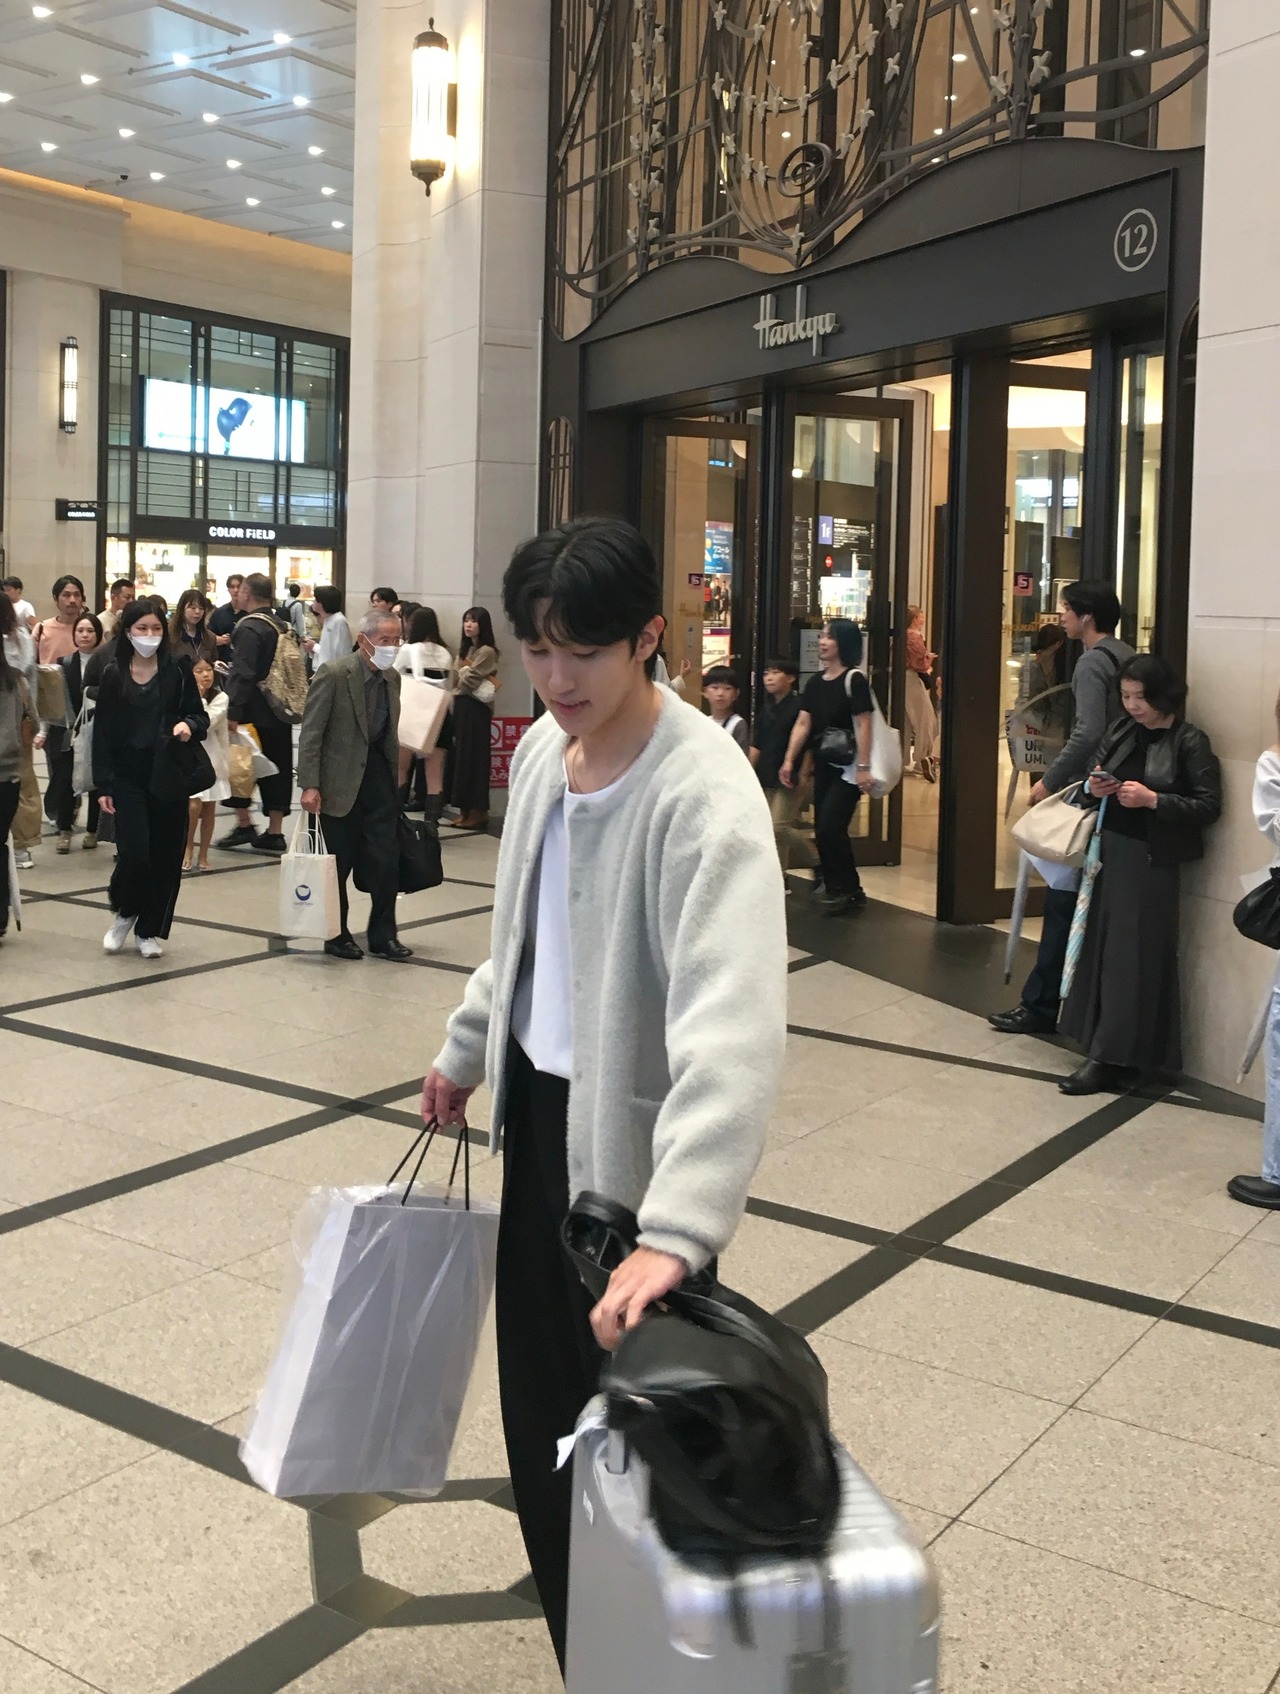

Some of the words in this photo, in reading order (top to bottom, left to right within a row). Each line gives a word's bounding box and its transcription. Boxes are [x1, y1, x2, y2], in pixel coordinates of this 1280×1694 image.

[1121, 223, 1148, 258] 12
[753, 284, 839, 357] Hankyu
[209, 526, 244, 538] COLOR
